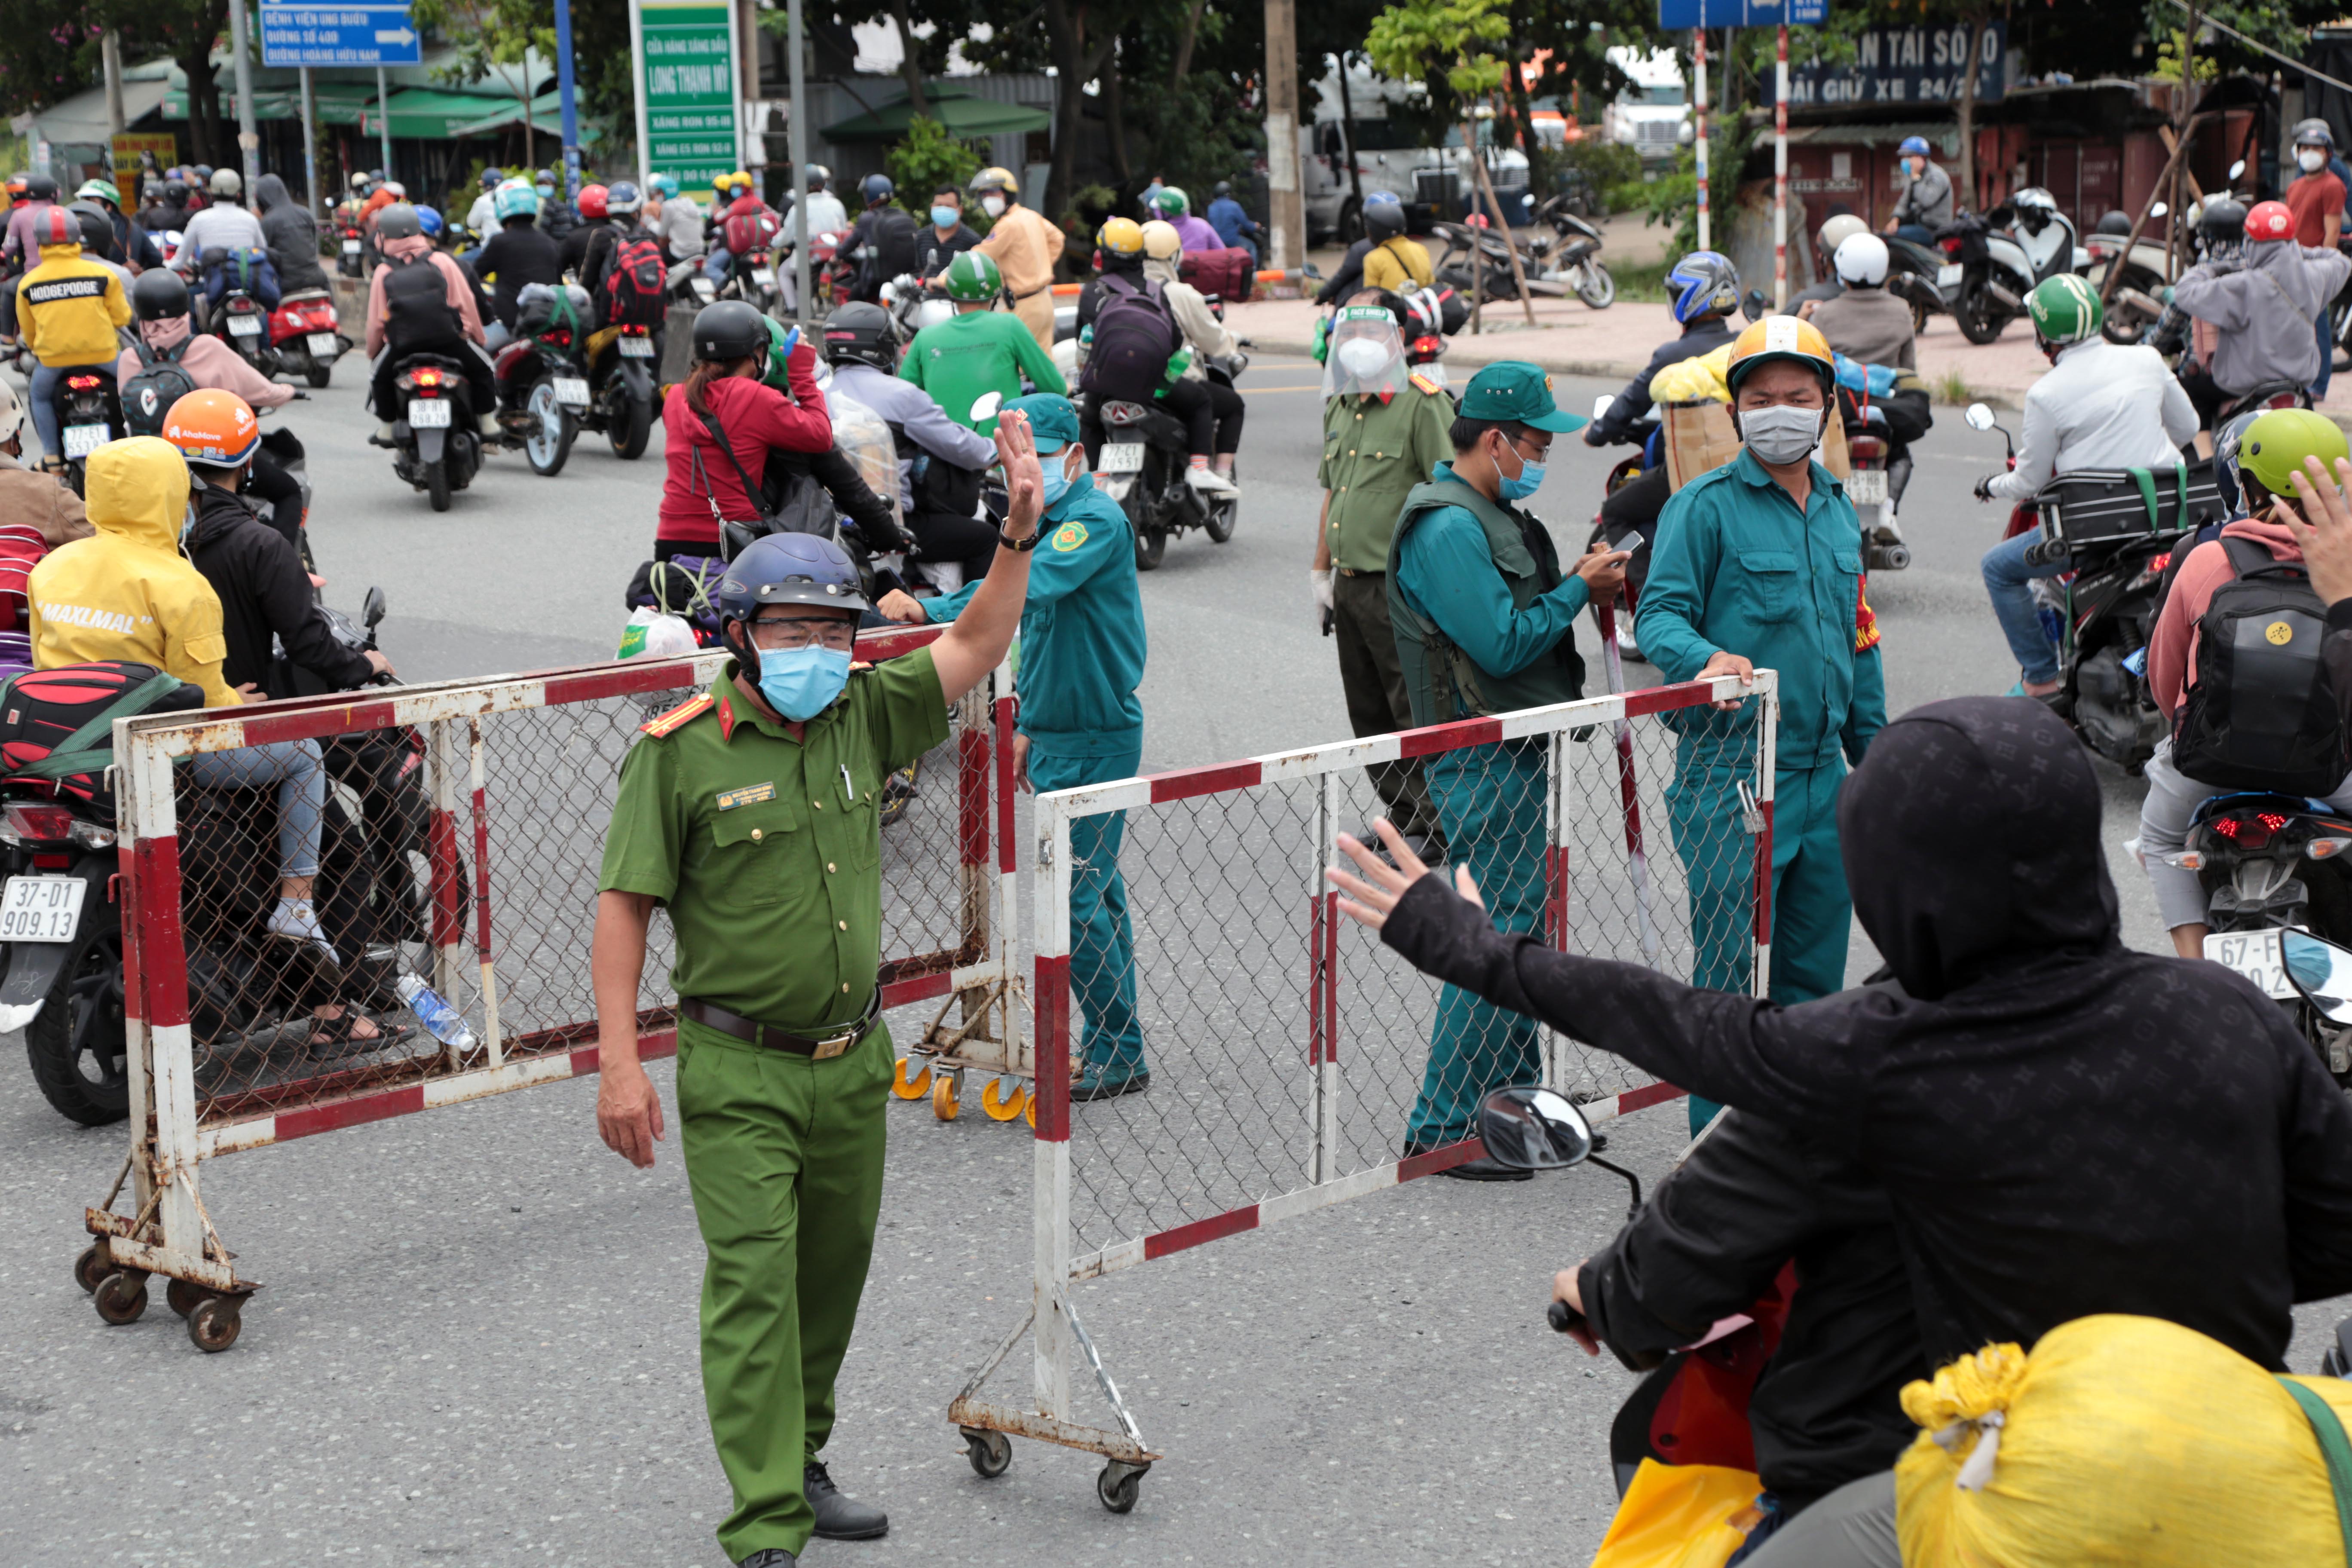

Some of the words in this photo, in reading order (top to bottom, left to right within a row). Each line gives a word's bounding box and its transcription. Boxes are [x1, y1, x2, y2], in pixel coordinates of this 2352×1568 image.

[318, 31, 339, 42] 400
[358, 49, 380, 61] NAM
[649, 65, 676, 95] LONG
[1875, 79, 1905, 101] XE
[681, 116, 703, 127] RON
[679, 144, 690, 153] E5
[692, 143, 710, 153] RON
[683, 170, 697, 181] DO
[30, 281, 99, 302] HODGEPODGE
[1365, 308, 1386, 316] SHIELD
[182, 430, 222, 441] AhaMove
[16, 882, 71, 907] 37-D1
[3, 911, 72, 936] 909.13
